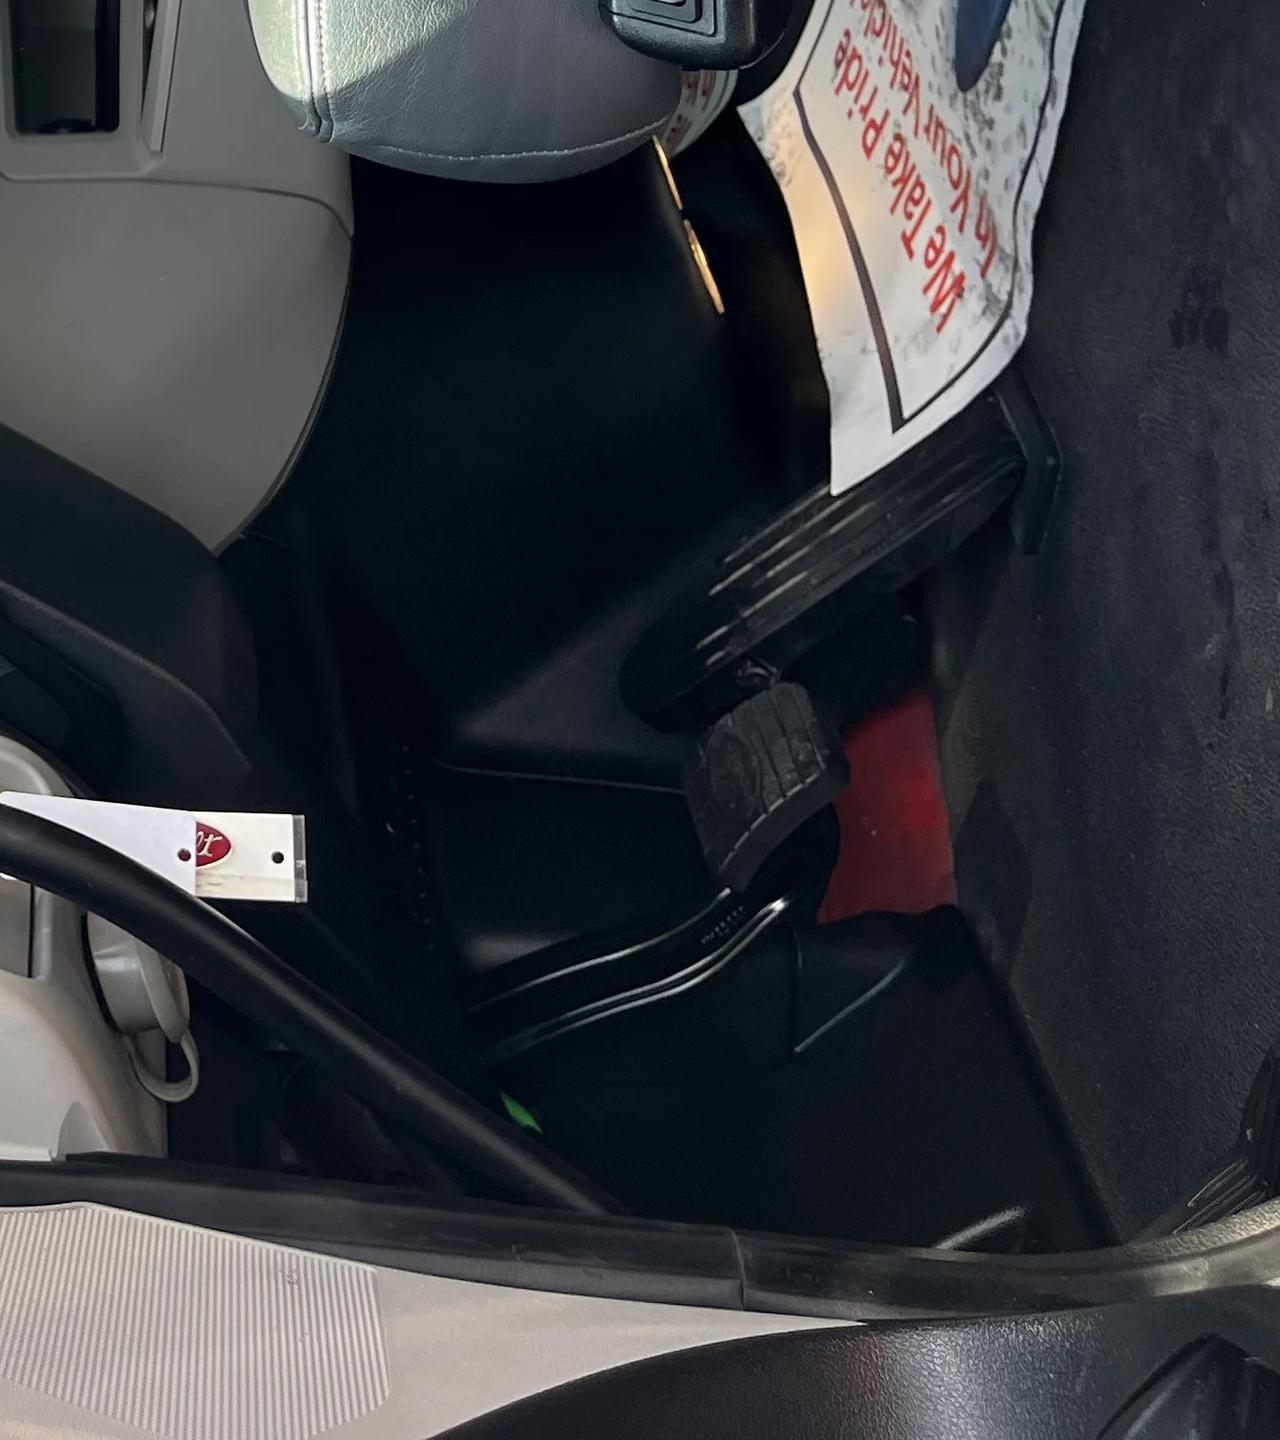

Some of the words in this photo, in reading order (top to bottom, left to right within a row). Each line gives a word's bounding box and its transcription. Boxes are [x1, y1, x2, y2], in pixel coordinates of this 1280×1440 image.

[831, 28, 890, 160] Pride
[881, 131, 931, 260] Take
[921, 102, 972, 236] Your
[921, 225, 966, 334] We
[974, 190, 998, 279] In
